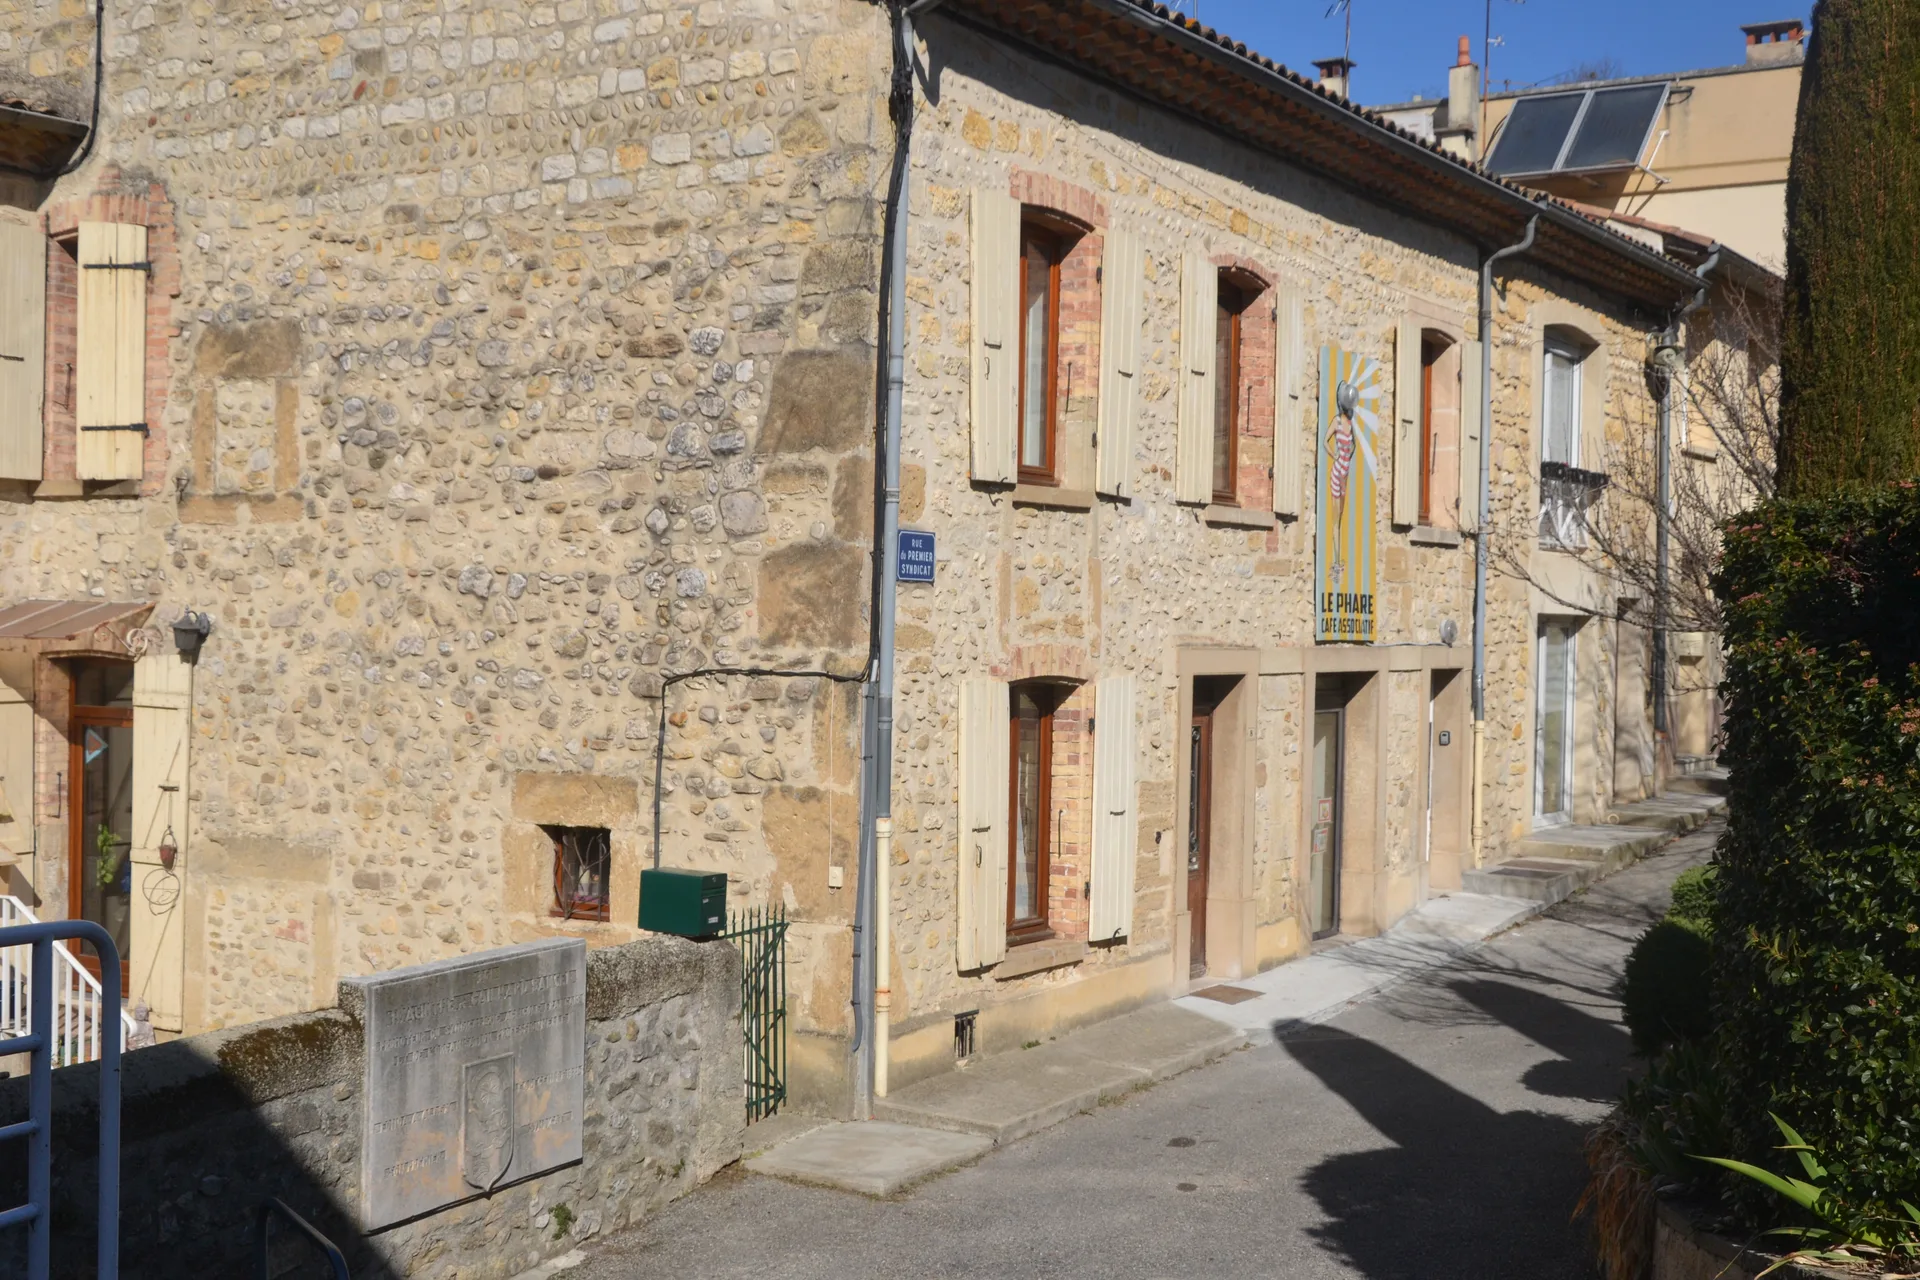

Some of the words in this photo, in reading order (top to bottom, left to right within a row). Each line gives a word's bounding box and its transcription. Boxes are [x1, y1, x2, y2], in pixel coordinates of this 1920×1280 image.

[912, 538, 923, 548] RUE
[908, 550, 933, 562] PREMIER
[901, 563, 931, 576] SYNDICAT
[1321, 592, 1333, 612] LE
[1336, 593, 1373, 614] PHARE
[1338, 618, 1373, 634] ASSOCIATIF
